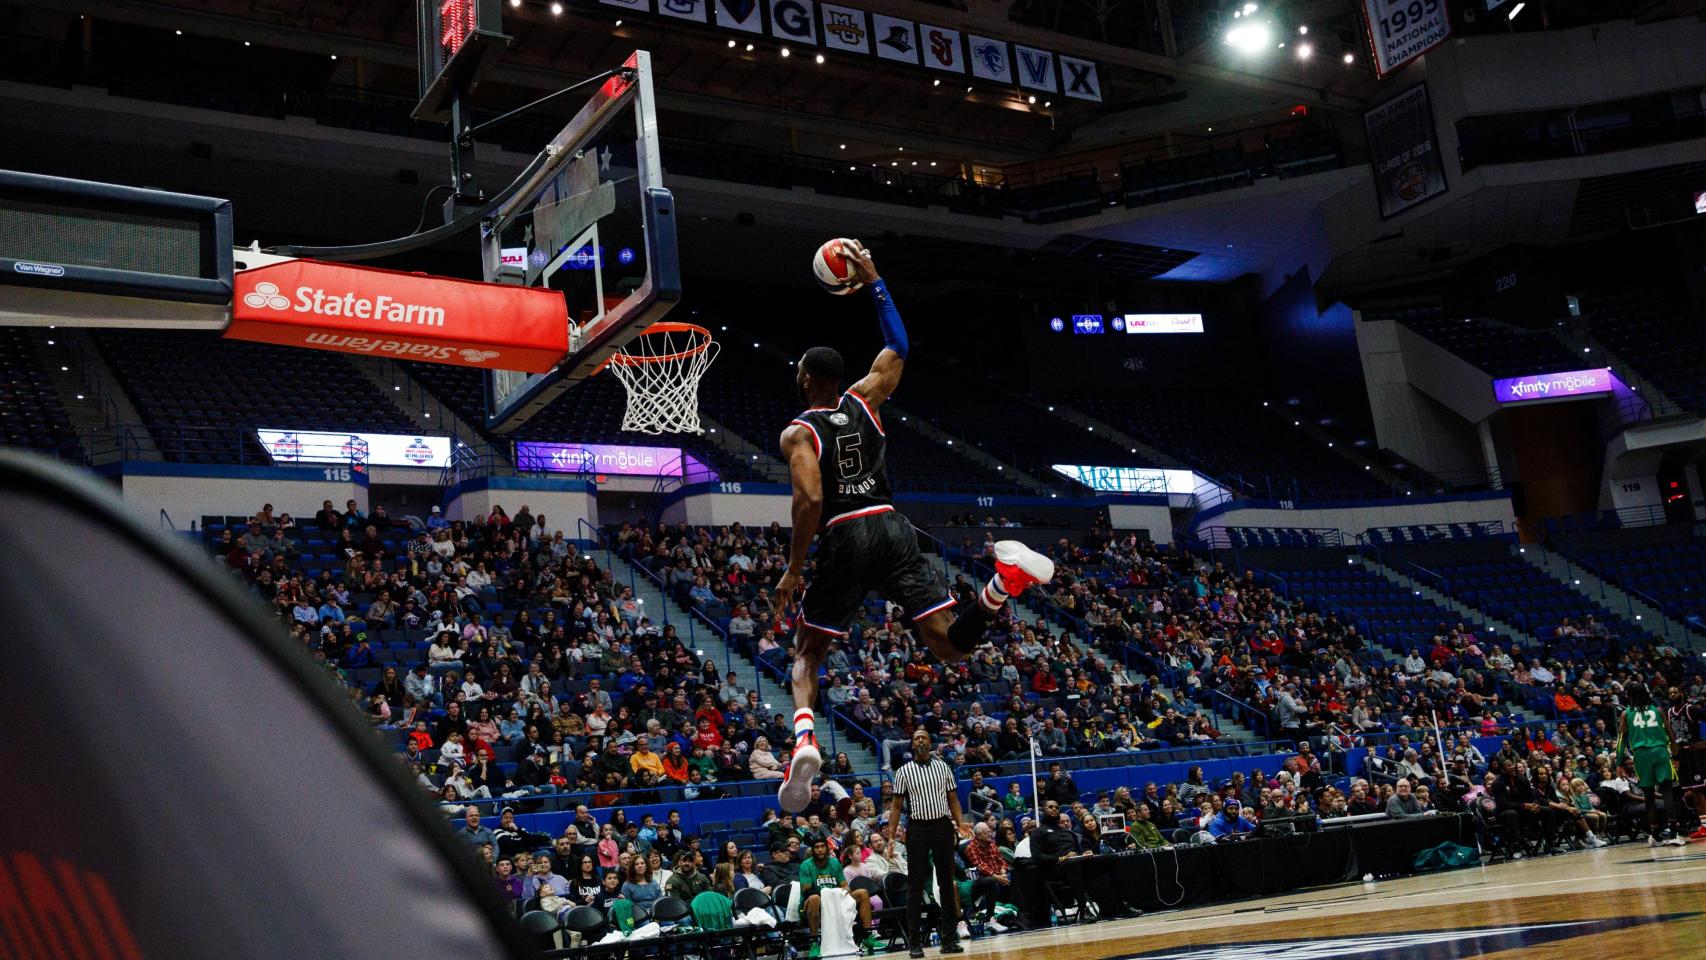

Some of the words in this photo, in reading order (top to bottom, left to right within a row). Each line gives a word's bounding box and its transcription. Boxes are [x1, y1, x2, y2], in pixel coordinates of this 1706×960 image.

[773, 0, 811, 38] G
[1380, 0, 1438, 38] 1995
[1387, 17, 1441, 52] NATIONAL
[1387, 26, 1446, 66] CHAMPIONS
[1017, 48, 1050, 87] V
[1063, 59, 1097, 97] X
[34, 265, 61, 274] Wagner
[1496, 272, 1517, 292] 220
[1510, 380, 1550, 397] xfinity
[1552, 376, 1596, 392] mobile
[551, 449, 599, 467] xfinity
[602, 451, 653, 469] mobile
[836, 432, 863, 479] 5
[323, 469, 351, 482] 115
[1076, 465, 1126, 490] M&T
[720, 482, 742, 493] 116
[1622, 482, 1641, 493] 119
[977, 496, 994, 507] 117
[1279, 499, 1294, 510] 118
[1633, 710, 1659, 729] 42
